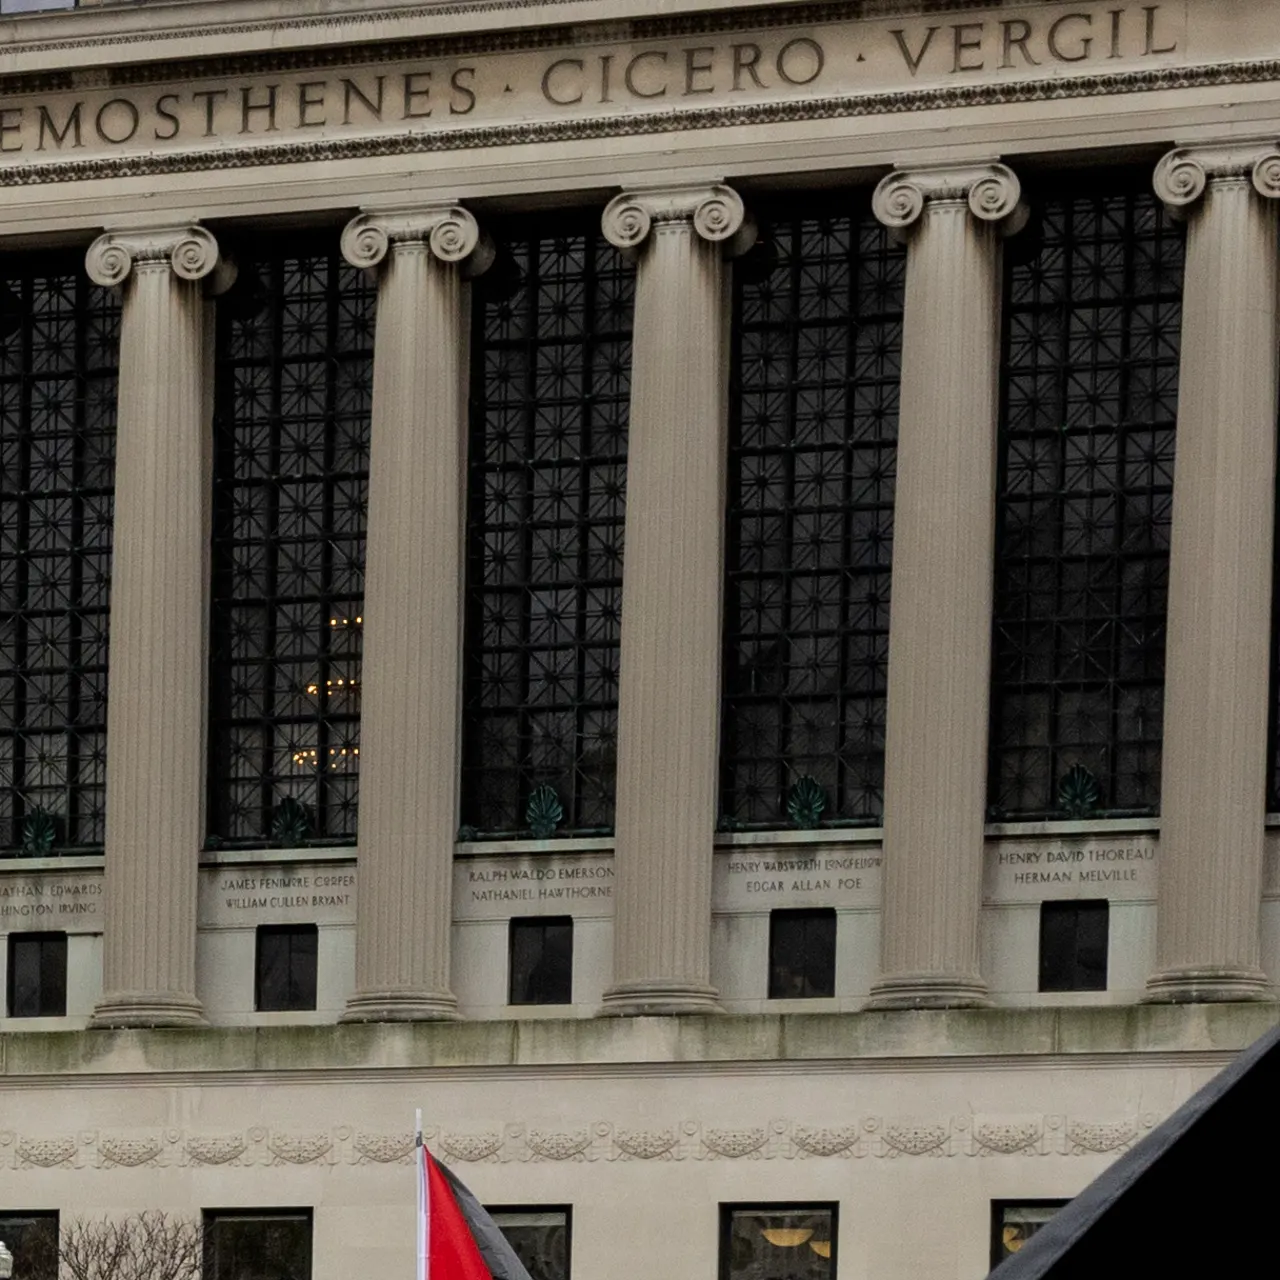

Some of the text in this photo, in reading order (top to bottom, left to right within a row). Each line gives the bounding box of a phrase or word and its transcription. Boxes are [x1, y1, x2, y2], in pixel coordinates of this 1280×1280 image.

[540, 36, 826, 106] CICERO
[889, 7, 1178, 78] VERGIL
[998, 849, 1155, 865] HENRY DAVID THOREAU
[728, 861, 761, 873] HENRY
[469, 867, 615, 882] RALPH WALDO EMERSON
[1015, 869, 1137, 884] HERMAN MELVILLE
[50, 884, 102, 896] EDWARDS
[221, 879, 256, 890] JAMES
[747, 878, 862, 892] EDGAR ALLAN POE
[471, 886, 612, 901] NATHANIEL HAWTHORNE
[59, 903, 97, 914] IRVING
[226, 895, 350, 909] WILLIAM CULLEN BRYANT
